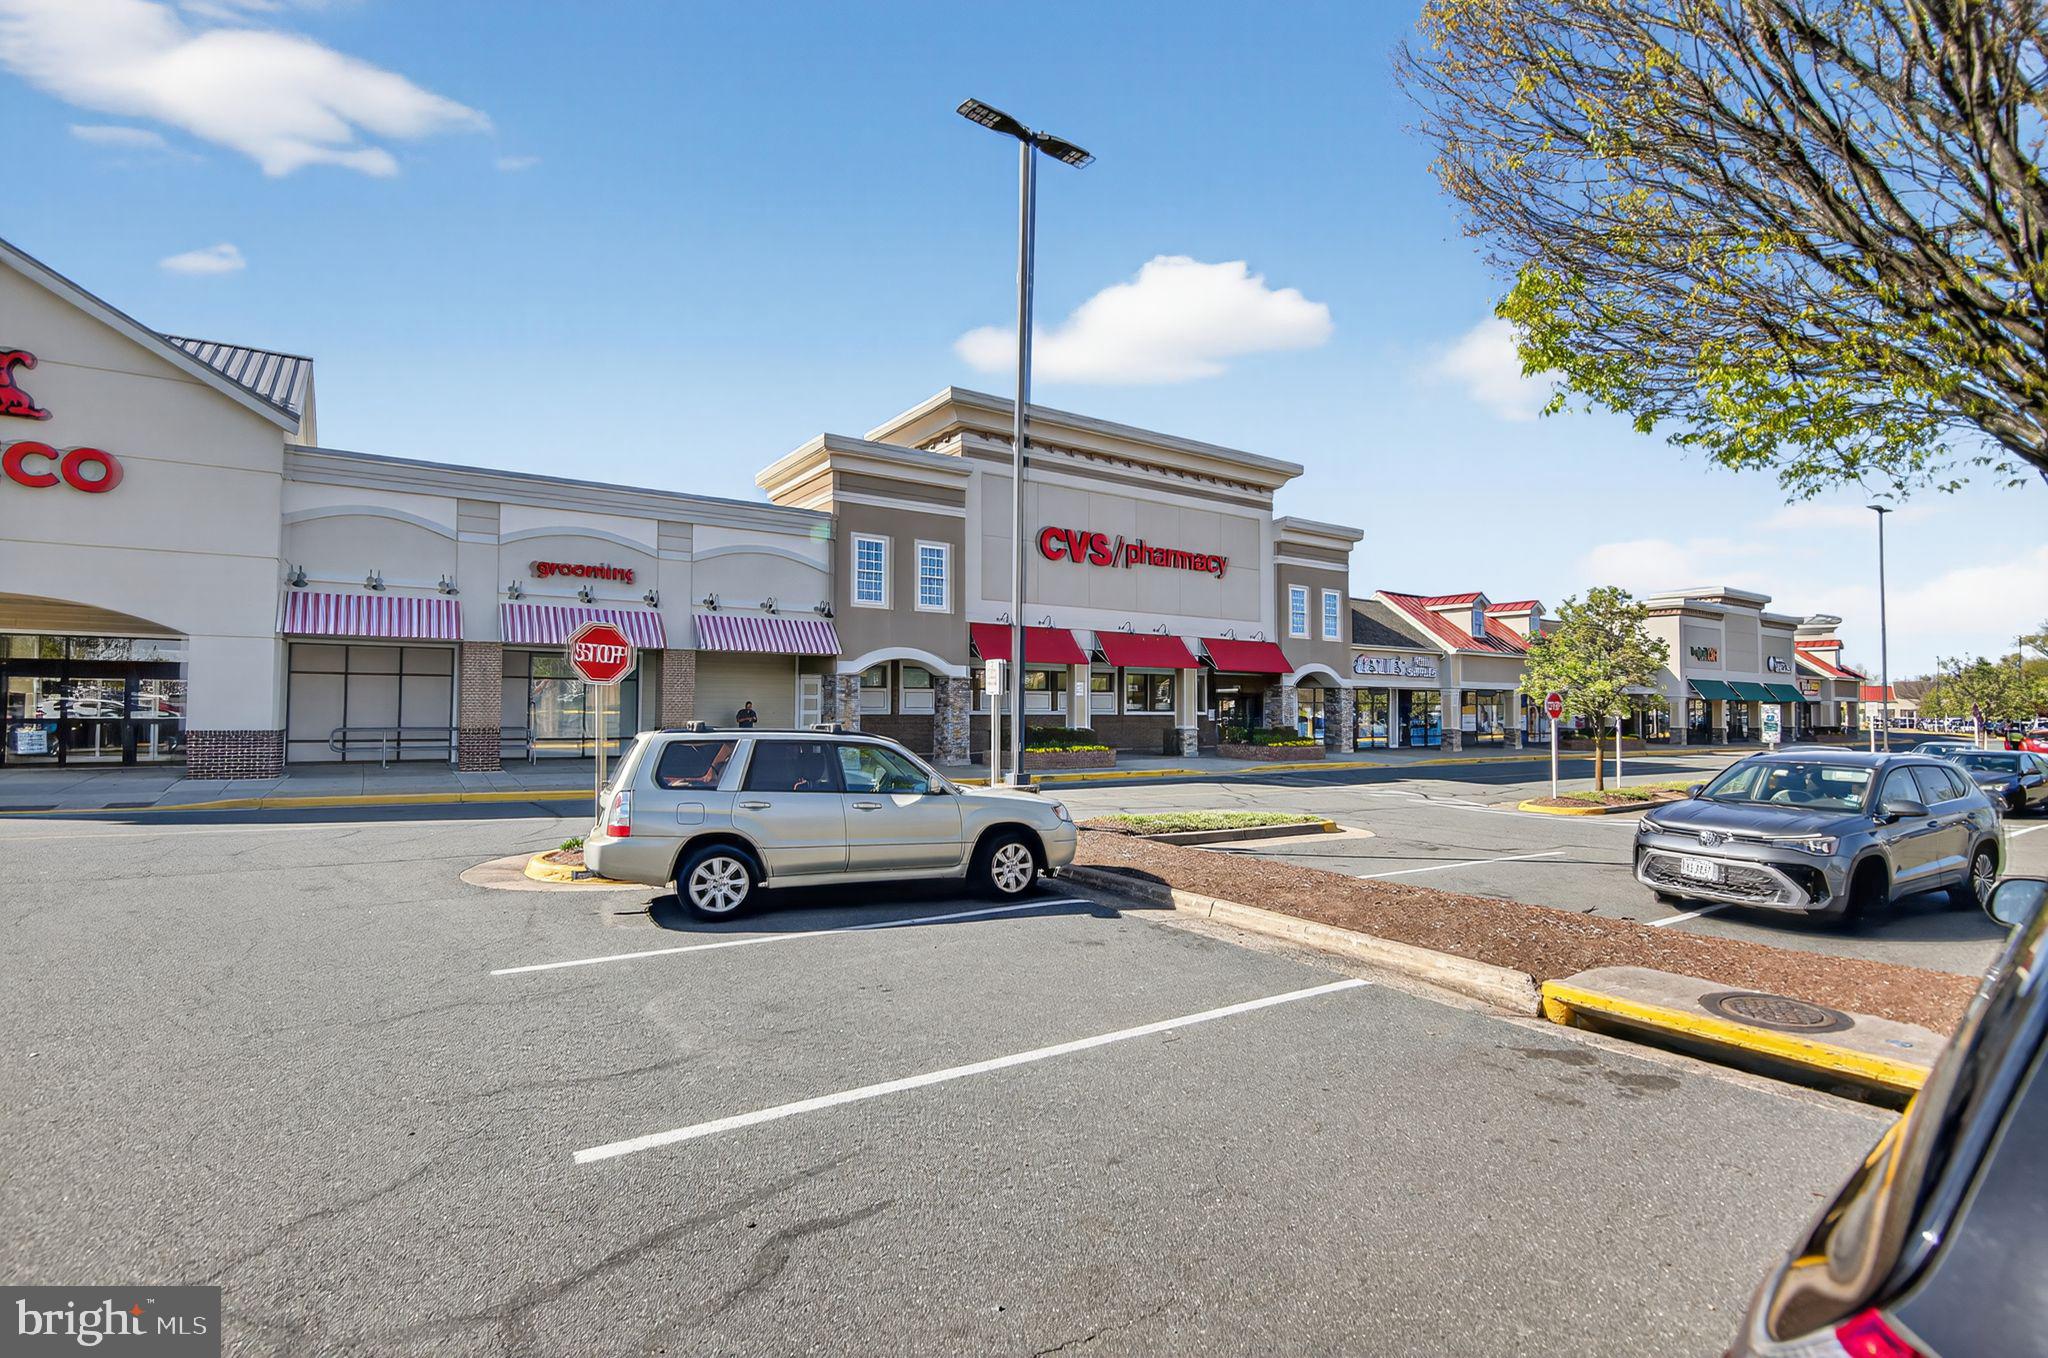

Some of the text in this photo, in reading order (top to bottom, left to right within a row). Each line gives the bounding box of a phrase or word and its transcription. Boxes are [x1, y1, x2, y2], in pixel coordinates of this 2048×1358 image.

[0, 441, 124, 493] CO
[534, 561, 636, 585] grooming
[575, 643, 627, 664] STOP
